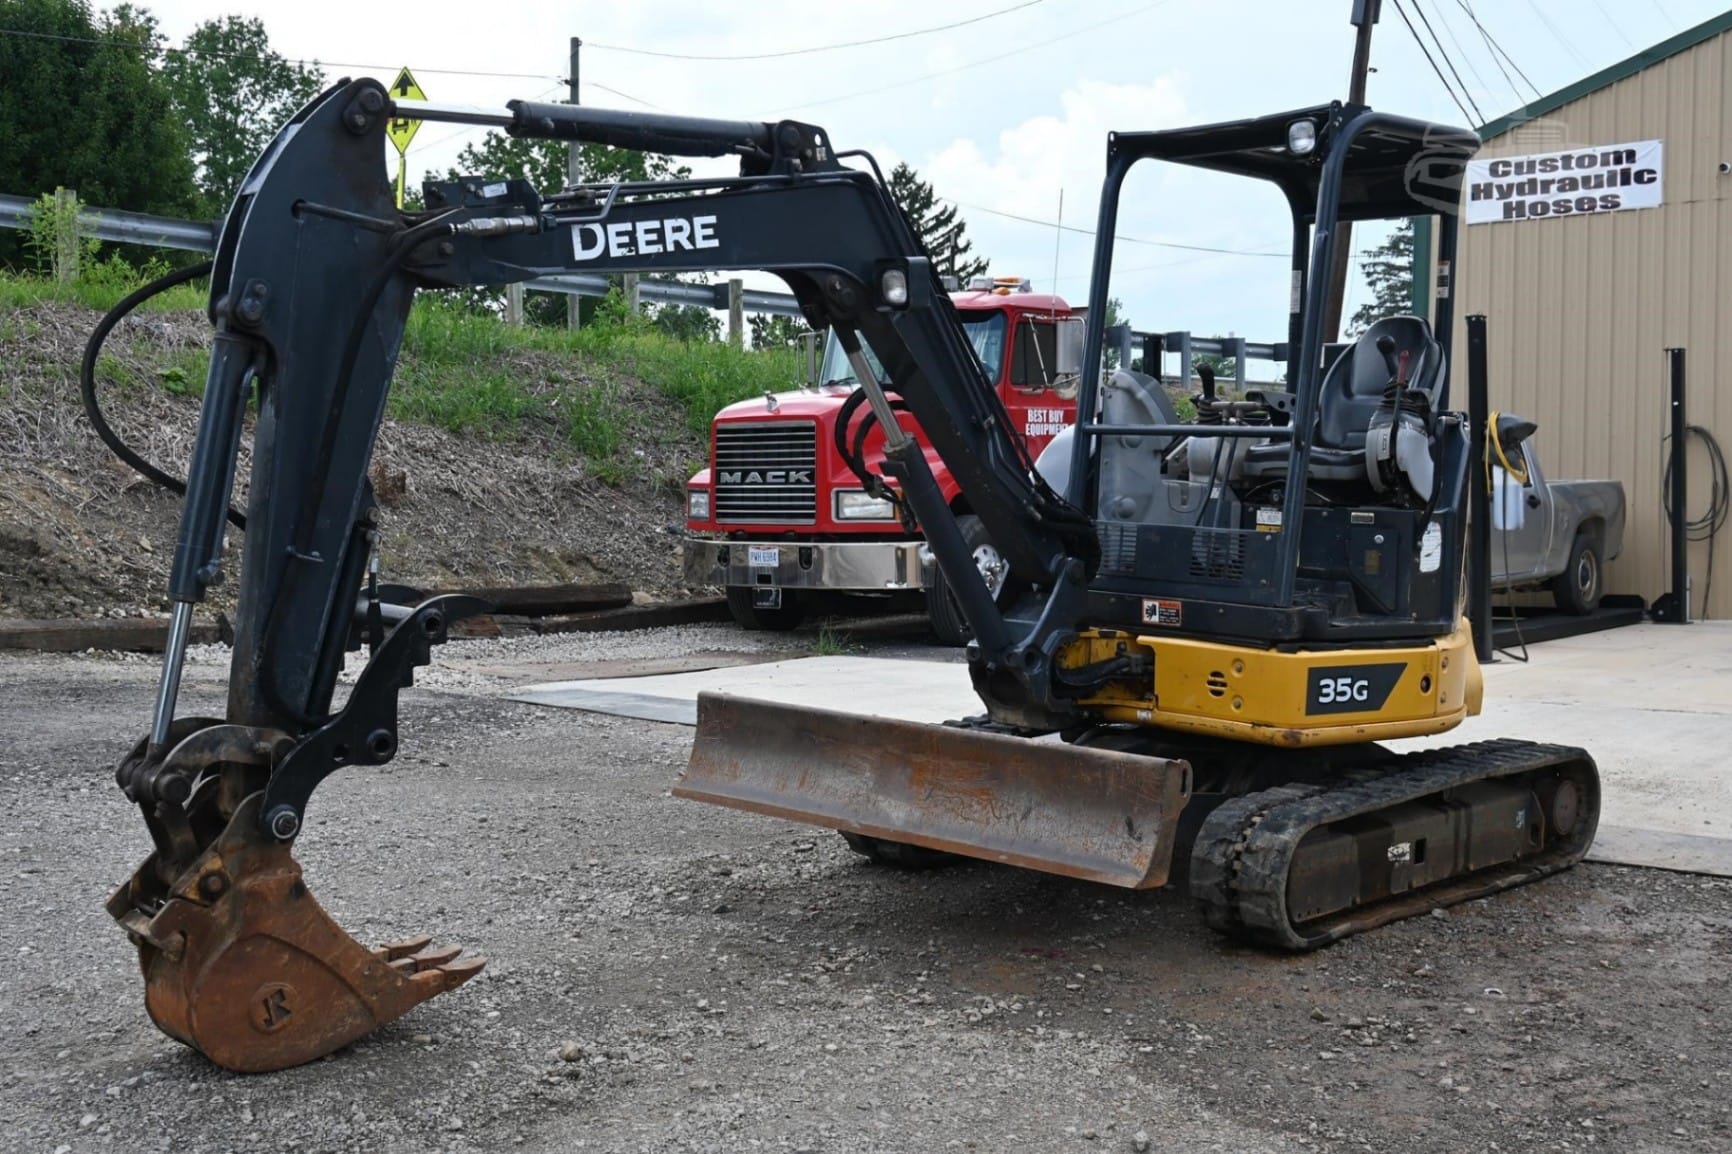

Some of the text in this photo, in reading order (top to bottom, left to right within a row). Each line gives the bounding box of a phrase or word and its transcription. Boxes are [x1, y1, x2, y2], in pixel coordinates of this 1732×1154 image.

[1488, 148, 1637, 178] Custom
[1470, 167, 1658, 201] Hydraulic
[1502, 194, 1621, 220] Hoses
[571, 215, 720, 262] DEERE
[1027, 409, 1064, 423] BEST BUY
[720, 471, 811, 483] MACK
[1318, 677, 1369, 704] 35G
